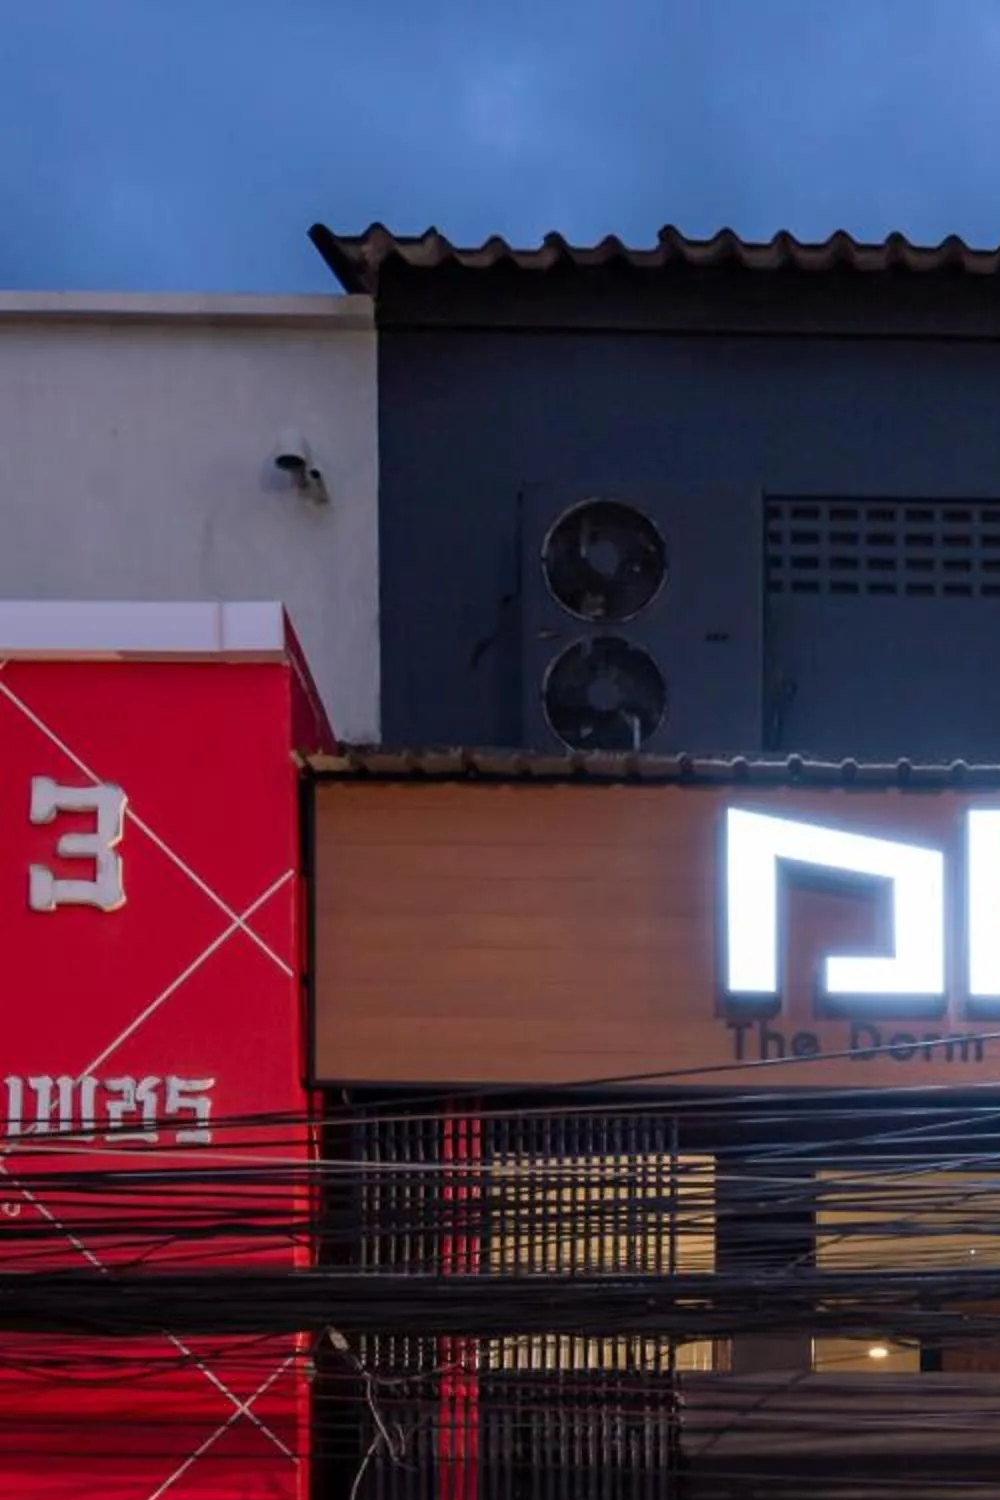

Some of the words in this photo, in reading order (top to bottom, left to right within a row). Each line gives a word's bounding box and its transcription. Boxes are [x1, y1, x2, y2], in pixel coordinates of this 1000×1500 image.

[30, 775, 128, 912] 3
[725, 1022, 821, 1061] The
[849, 1025, 984, 1063] Dorm
